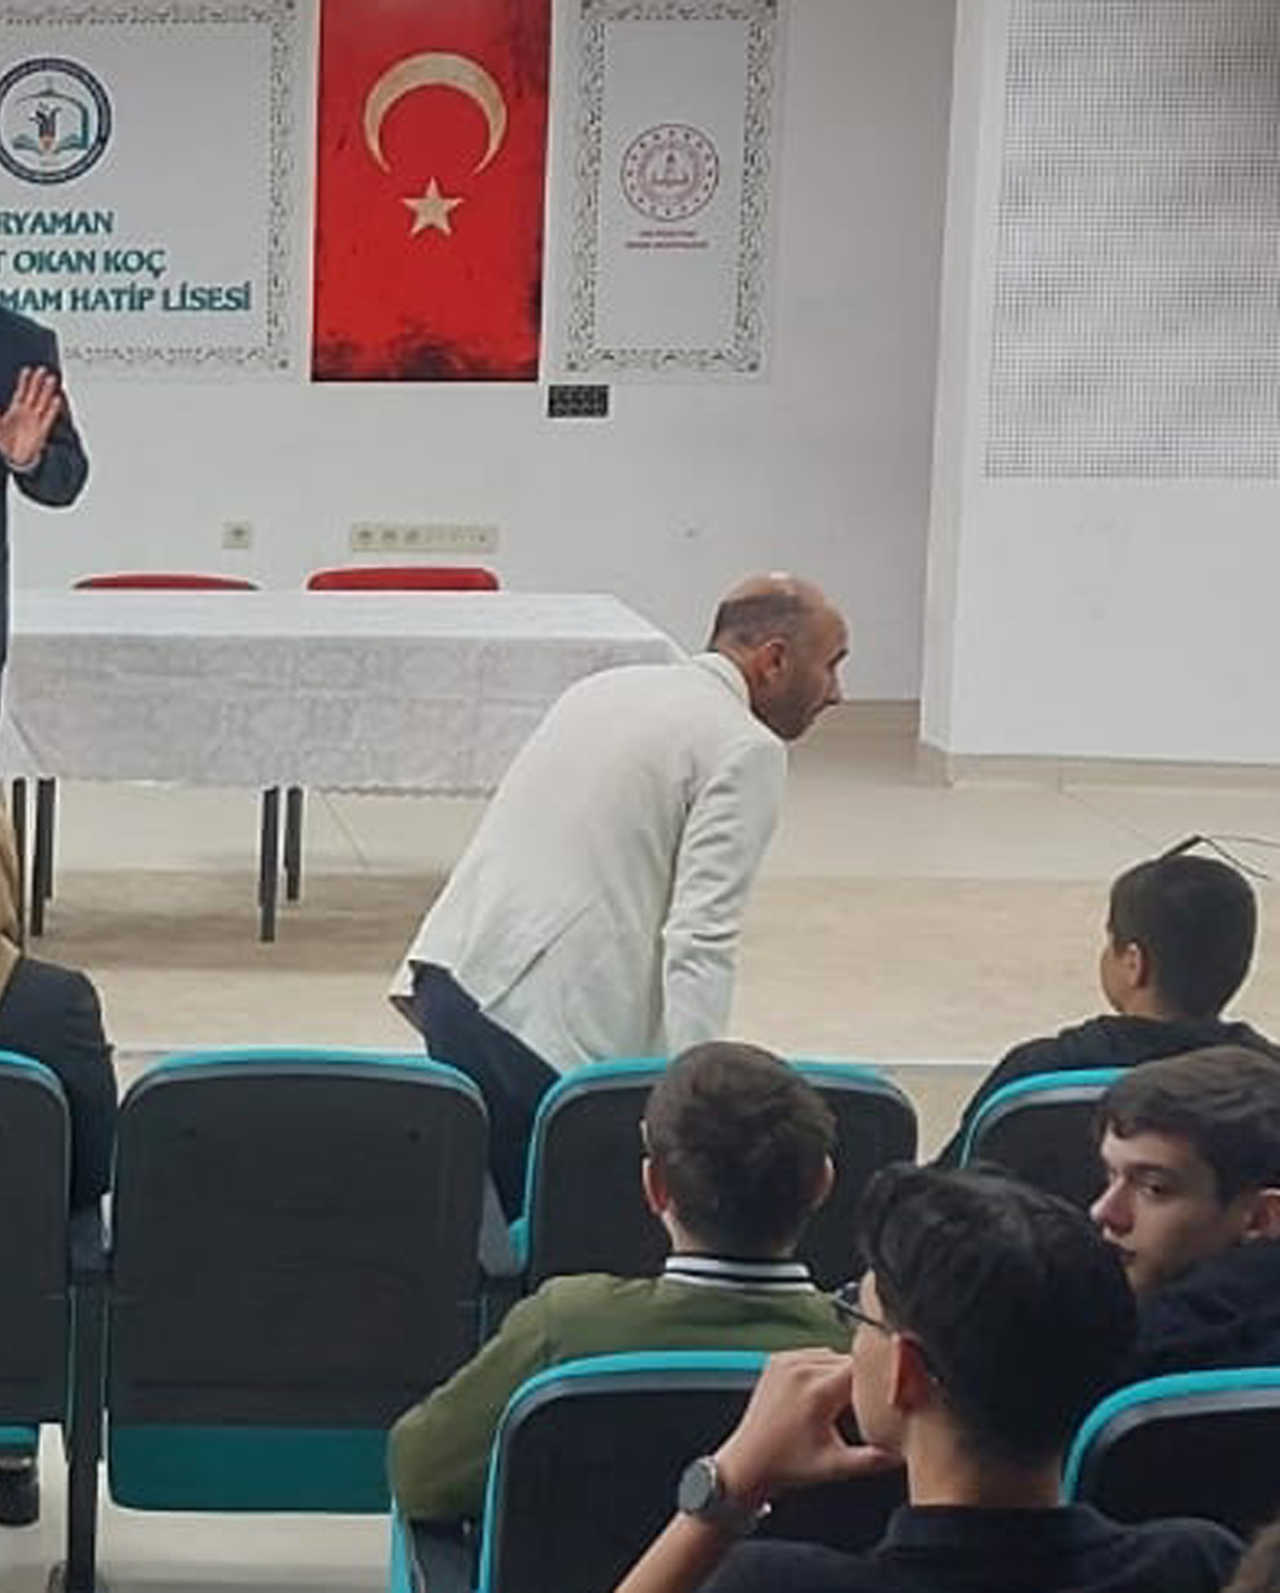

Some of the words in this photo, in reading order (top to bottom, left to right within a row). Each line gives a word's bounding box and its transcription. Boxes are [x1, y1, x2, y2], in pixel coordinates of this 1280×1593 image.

[13, 250, 96, 274] OKAN
[104, 250, 166, 279] KOÇ
[71, 281, 155, 312] HATİP
[163, 281, 252, 312] LİSESİ
